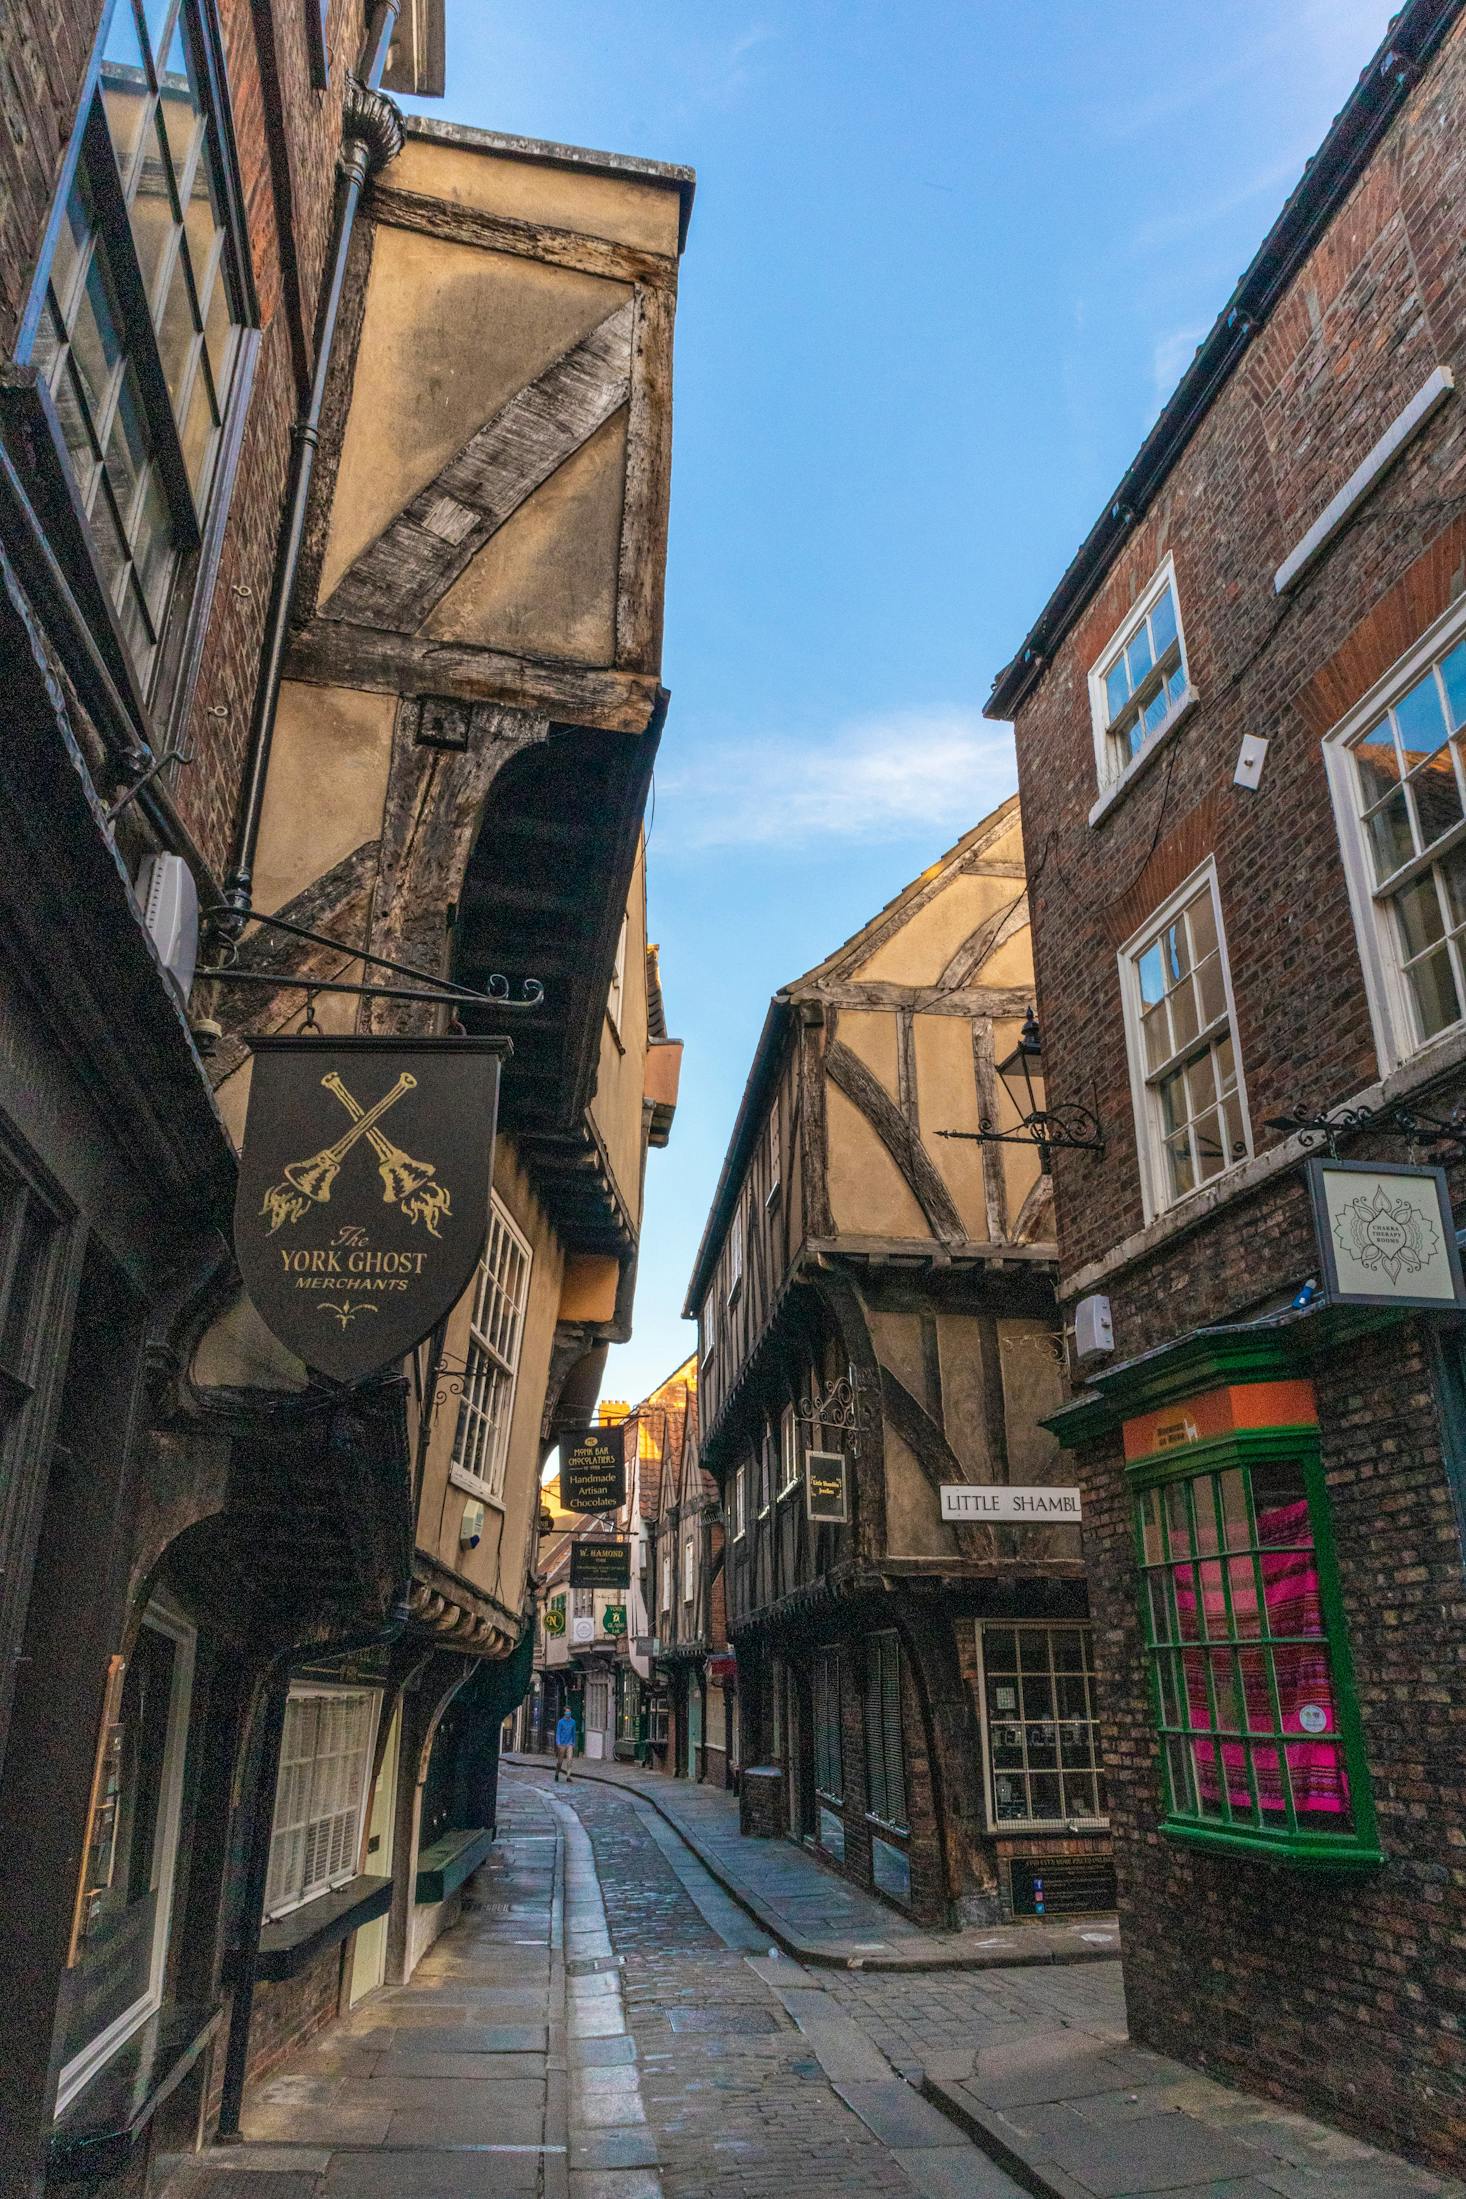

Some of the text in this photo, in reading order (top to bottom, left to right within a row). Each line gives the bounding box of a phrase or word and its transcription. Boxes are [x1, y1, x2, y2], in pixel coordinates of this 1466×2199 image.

[330, 1225, 369, 1247] The
[281, 1249, 428, 1274] YORK GHOST
[295, 1277, 409, 1291] MERCHANTS
[573, 1446, 609, 1457] MONK BAR
[568, 1455, 616, 1466] CHOCOLATIERS
[569, 1473, 617, 1484] Handmade
[578, 1486, 608, 1496] Artisan
[569, 1497, 617, 1508] Chocolates
[947, 1495, 1001, 1511] LITTLE
[590, 1549, 625, 1558] HAMOND
